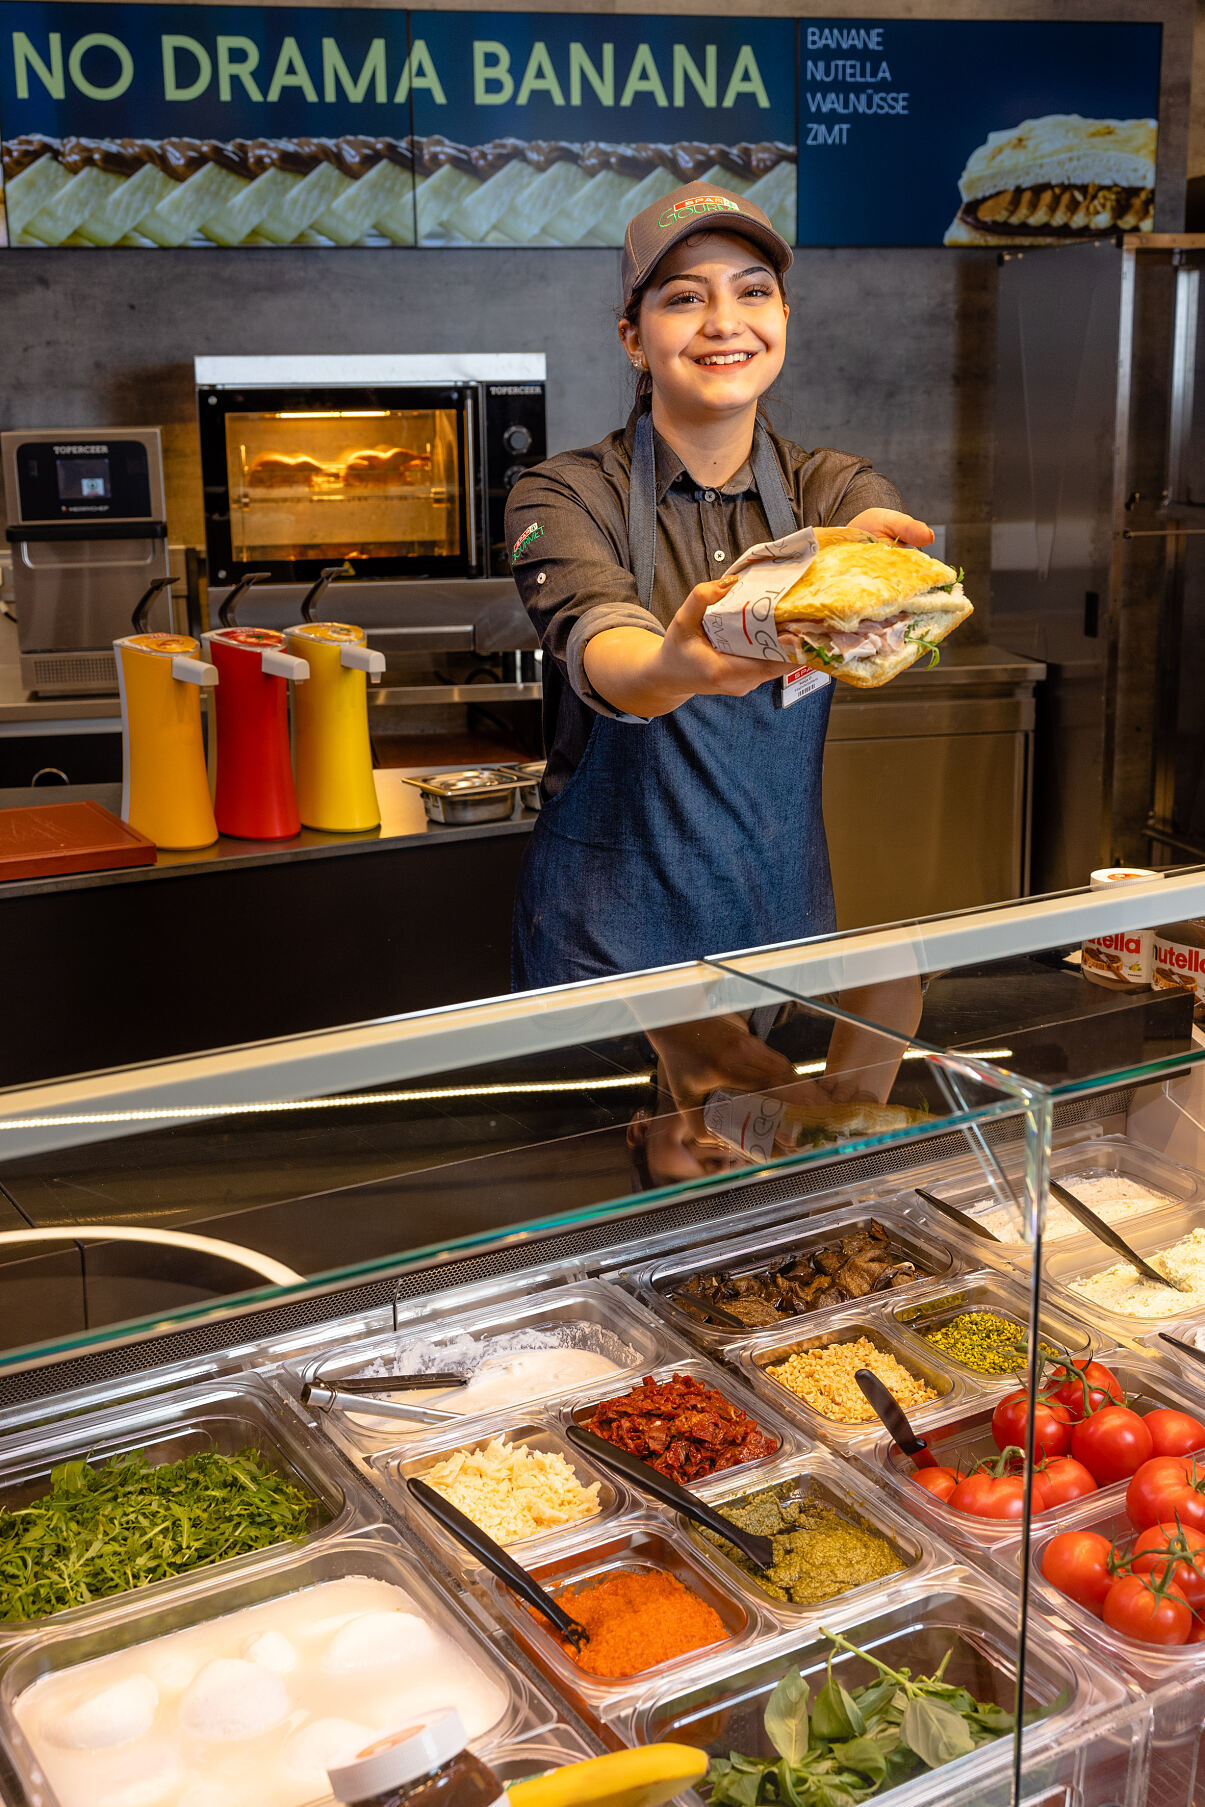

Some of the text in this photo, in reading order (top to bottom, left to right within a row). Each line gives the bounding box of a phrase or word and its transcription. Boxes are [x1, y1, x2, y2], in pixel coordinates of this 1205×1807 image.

[807, 27, 885, 50] BANANE
[12, 31, 771, 108] NO DRAMA BANANA
[806, 60, 892, 82] NUTELLA
[806, 89, 910, 115] WALNÜSSE
[806, 123, 852, 146] ZIMT
[751, 586, 786, 622] TO
